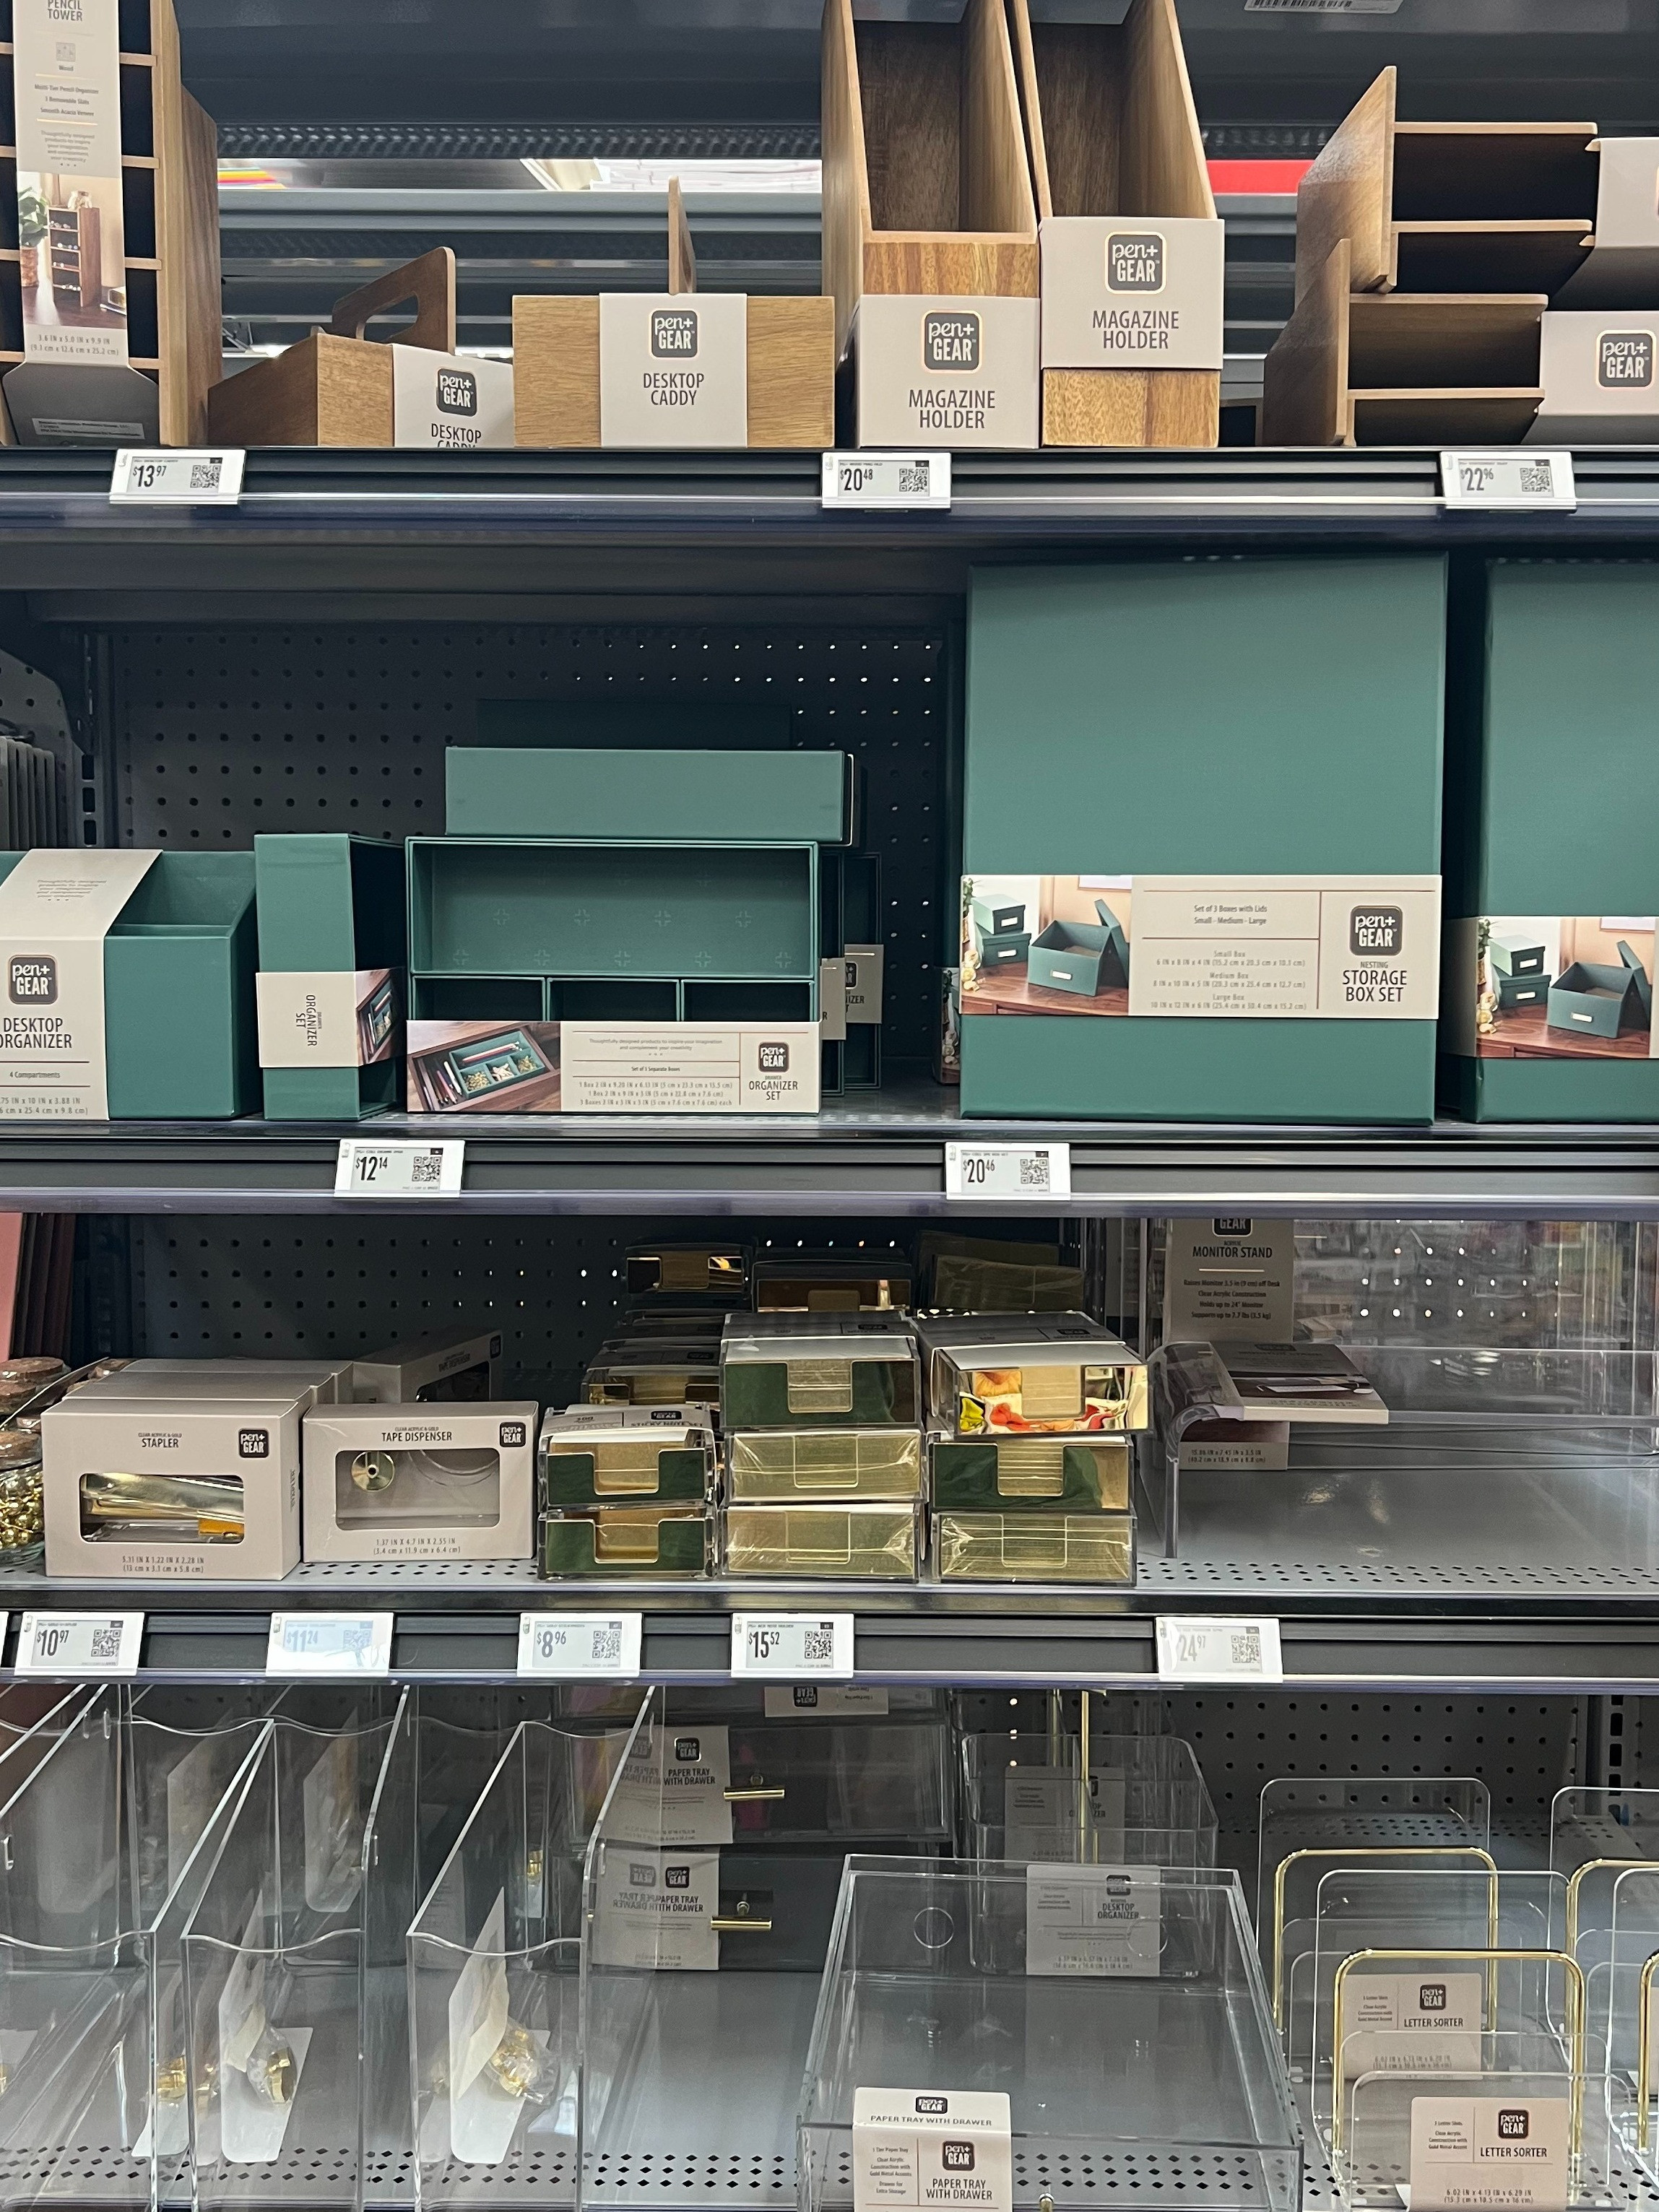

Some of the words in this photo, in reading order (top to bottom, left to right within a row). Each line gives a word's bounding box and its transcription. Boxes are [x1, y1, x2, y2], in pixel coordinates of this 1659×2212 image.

[48, 0, 82, 10] PENCIL
[48, 9, 82, 21] TOWER
[1112, 244, 1158, 265] pen+
[1117, 259, 1156, 282] GEAR
[654, 317, 693, 335] pen+
[1093, 311, 1179, 329] MAGAZINE
[658, 330, 691, 350] GEAR
[928, 322, 974, 344] pen+
[1103, 330, 1169, 349] HOLDER
[932, 338, 972, 361] GEAR
[1602, 342, 1647, 362] pen+
[1606, 356, 1644, 378] GEAR
[440, 375, 472, 391] pen+
[644, 373, 705, 389] DESKTOP
[443, 388, 471, 407] GEAR
[651, 390, 697, 406] CADDY
[909, 389, 995, 408] MAGAZINE
[919, 409, 985, 428] HOLDER
[431, 422, 482, 443] DESKTOP
[1355, 915, 1395, 933] pen+
[1358, 928, 1393, 947] GEAR
[12, 964, 51, 981] pen+
[1343, 970, 1408, 985] STORAGE
[16, 976, 49, 995] GEAR
[1346, 986, 1374, 1002] BOX
[1378, 986, 1404, 1002] SET
[3, 1018, 64, 1033] DESKTOP
[295, 1013, 306, 1028] SET
[306, 994, 318, 1046] ORGANIZER
[761, 1047, 785, 1059] pen+
[763, 1055, 784, 1067] GEAR
[748, 1080, 798, 1090] ORGANIZER
[766, 1090, 781, 1101] SET
[1192, 1246, 1238, 1257] MONITOR
[1241, 1246, 1273, 1258] STAND
[142, 1438, 179, 1448] STAPLER
[241, 1434, 265, 1444] pen+
[381, 1432, 402, 1442] TAPE
[405, 1431, 452, 1442] DISPENSER
[503, 1433, 521, 1443] GEAR
[243, 1441, 264, 1453] GEAR
[685, 1777, 715, 1785] DRAWER
[660, 1895, 680, 1904] PAPER
[1102, 1903, 1135, 1912] DESKTOP
[1098, 1911, 1139, 1920] ORGANIZER
[1424, 1996, 1442, 2006] GEAR
[1404, 2018, 1431, 2027] LETTER
[1434, 2018, 1463, 2027] SORTER
[1500, 2115, 1525, 2125] pen+
[1502, 2122, 1524, 2134] GEAR
[945, 2145, 970, 2156] pen+
[1481, 2147, 1512, 2157] LETTER
[1514, 2147, 1547, 2157] SORTER
[948, 2153, 970, 2165] GEAR
[932, 2178, 961, 2189] PAPER
[963, 2179, 986, 2189] TRAY
[926, 2189, 950, 2199] WITH
[953, 2190, 992, 2200] DRAWER
